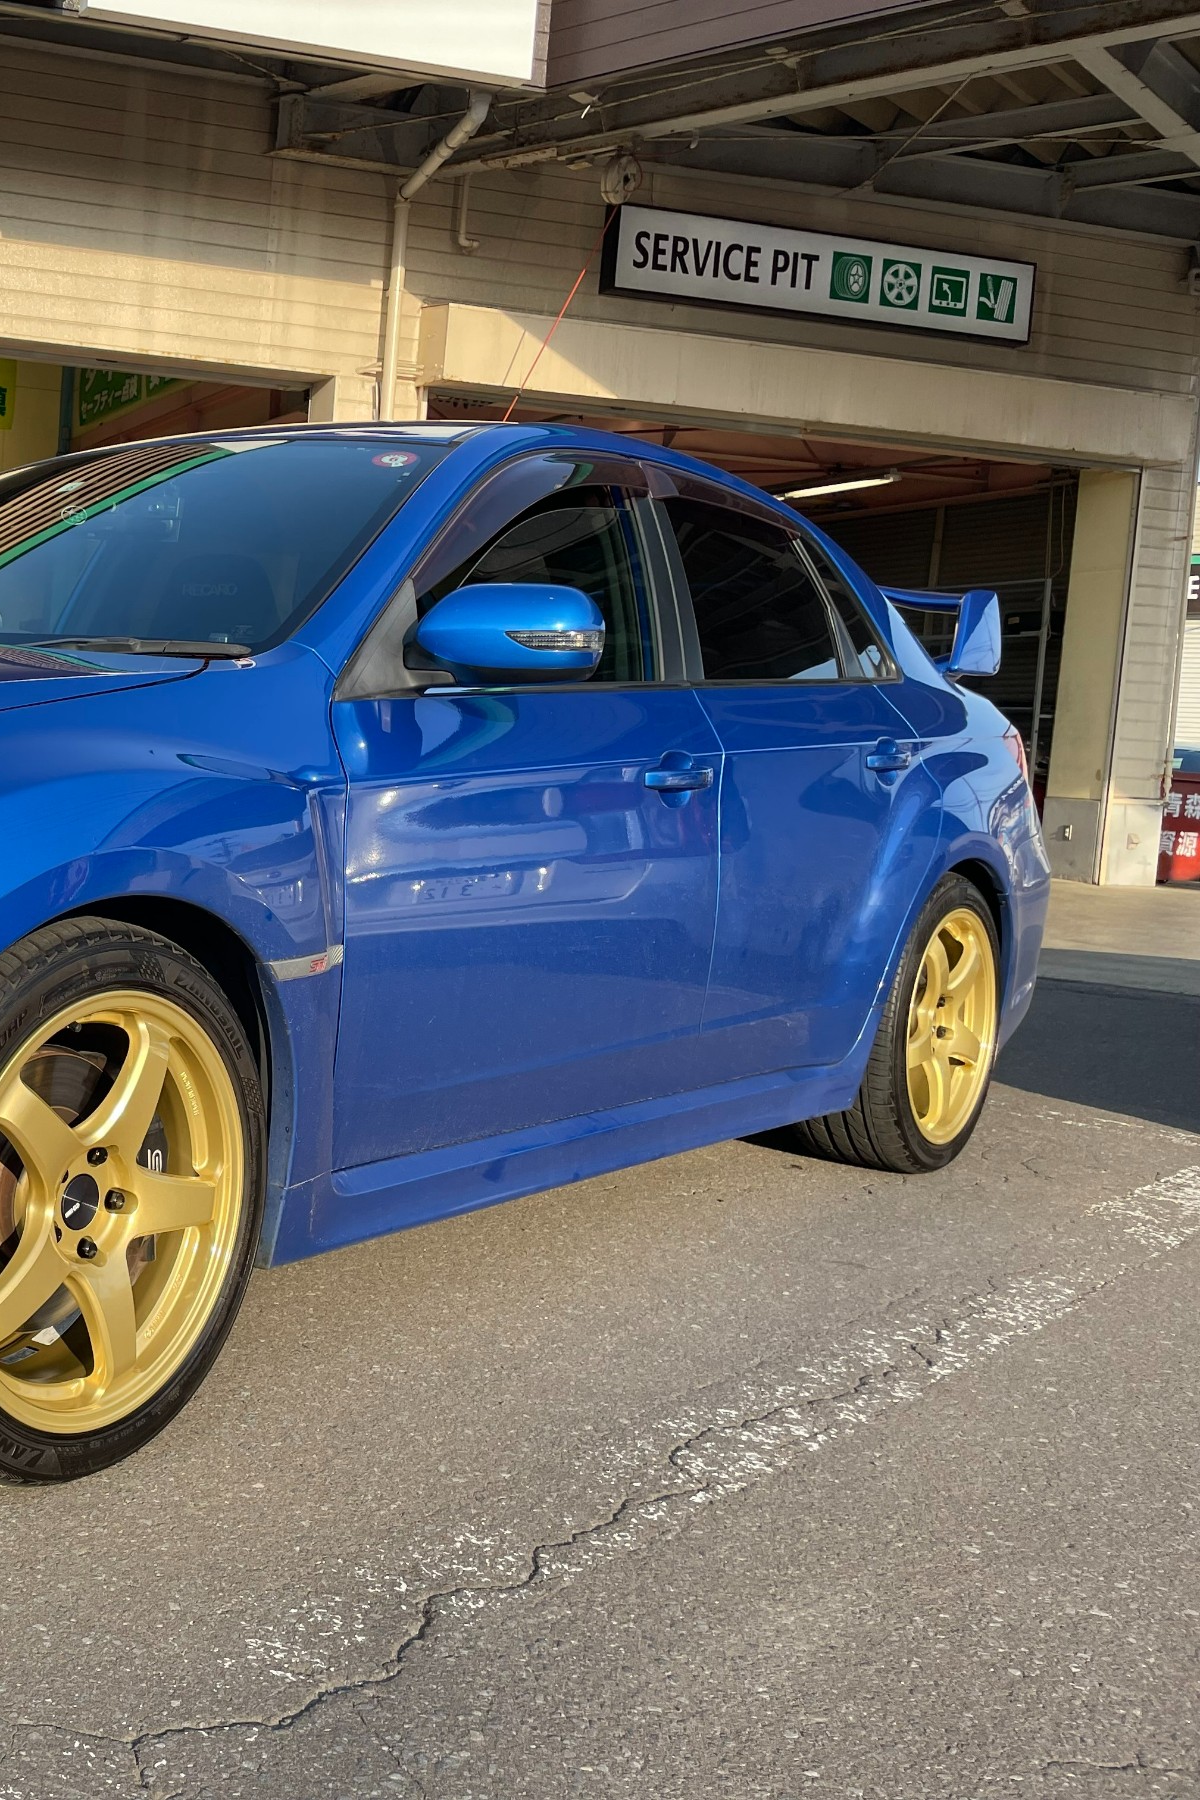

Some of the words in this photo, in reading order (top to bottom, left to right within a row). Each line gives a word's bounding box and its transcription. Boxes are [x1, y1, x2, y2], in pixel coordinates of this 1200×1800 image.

[632, 230, 761, 284] SERVICE
[770, 249, 820, 290] PIT
[181, 582, 238, 597] RECARO
